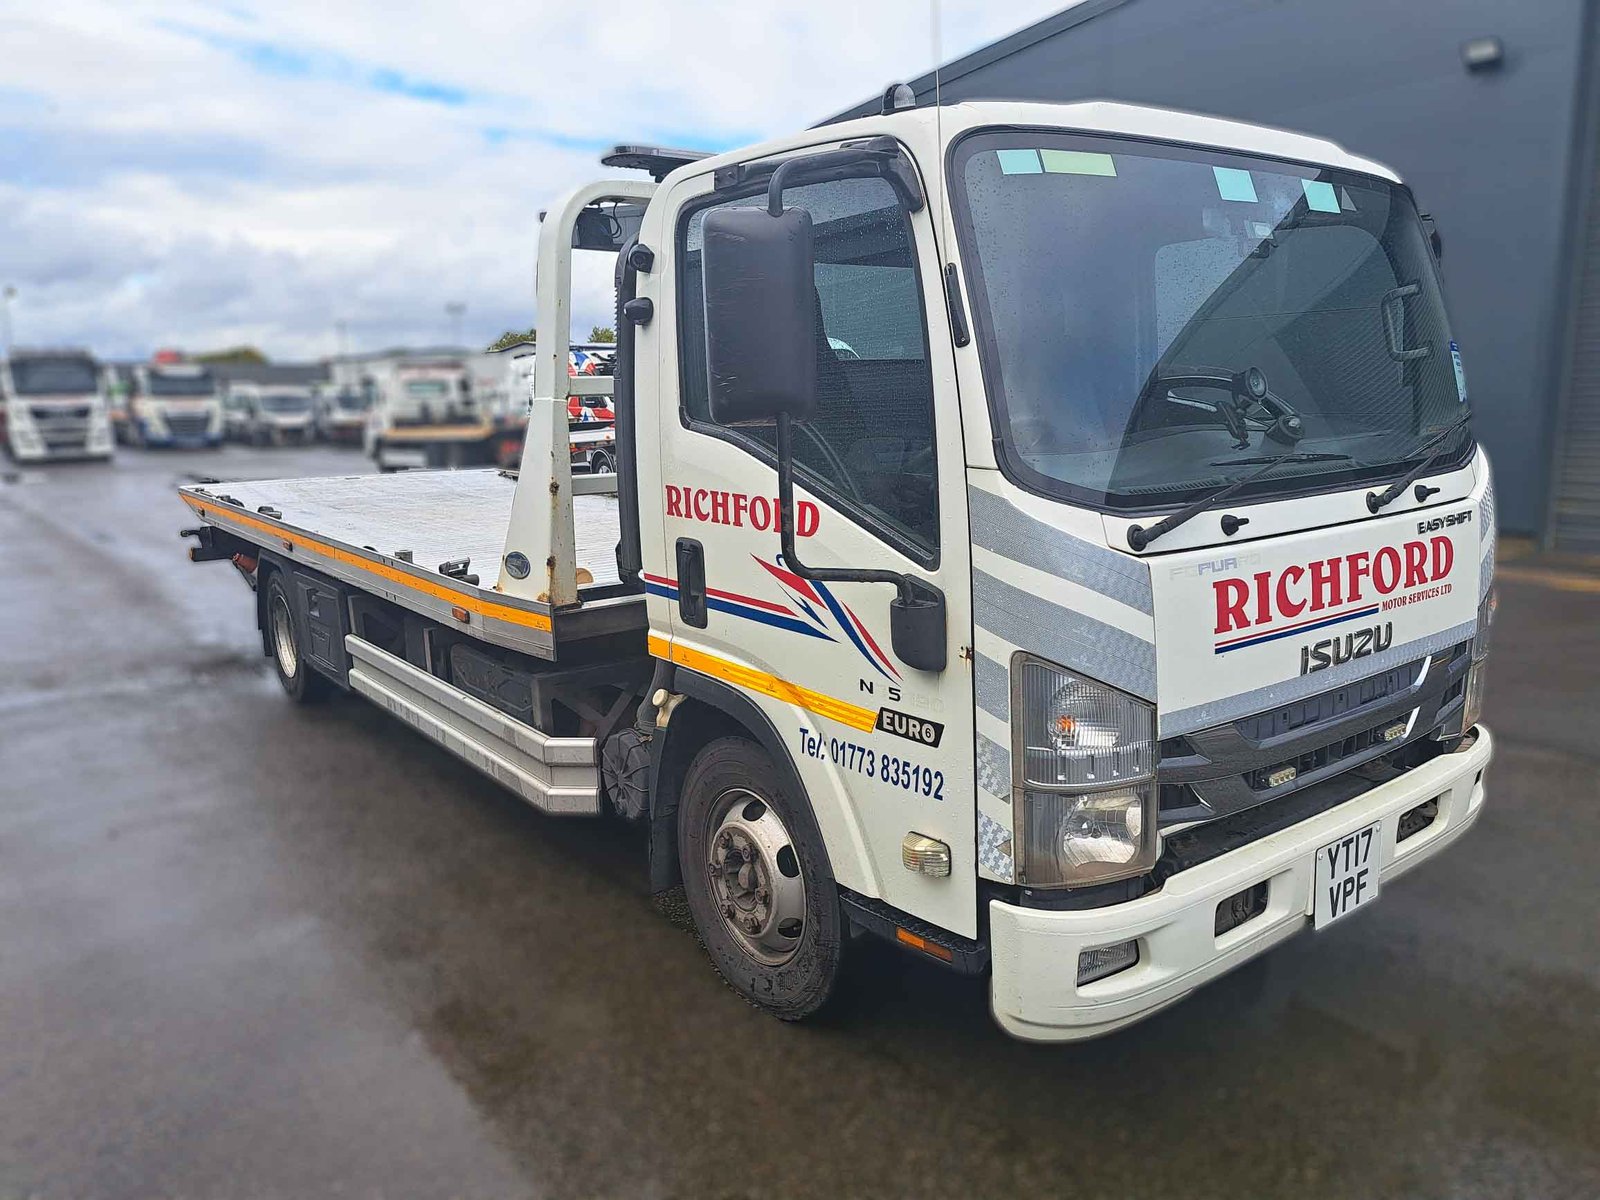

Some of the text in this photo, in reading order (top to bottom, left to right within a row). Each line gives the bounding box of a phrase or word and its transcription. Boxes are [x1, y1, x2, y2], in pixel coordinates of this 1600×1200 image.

[1212, 535, 1454, 634] RICHFORD
[1381, 583, 1453, 612] MOTOR SERVICES LTD
[1300, 621, 1393, 677] ISUZU
[799, 727, 945, 801] Tel: 01773 835192
[1327, 827, 1374, 880] YT17
[1329, 867, 1369, 919] VPF
